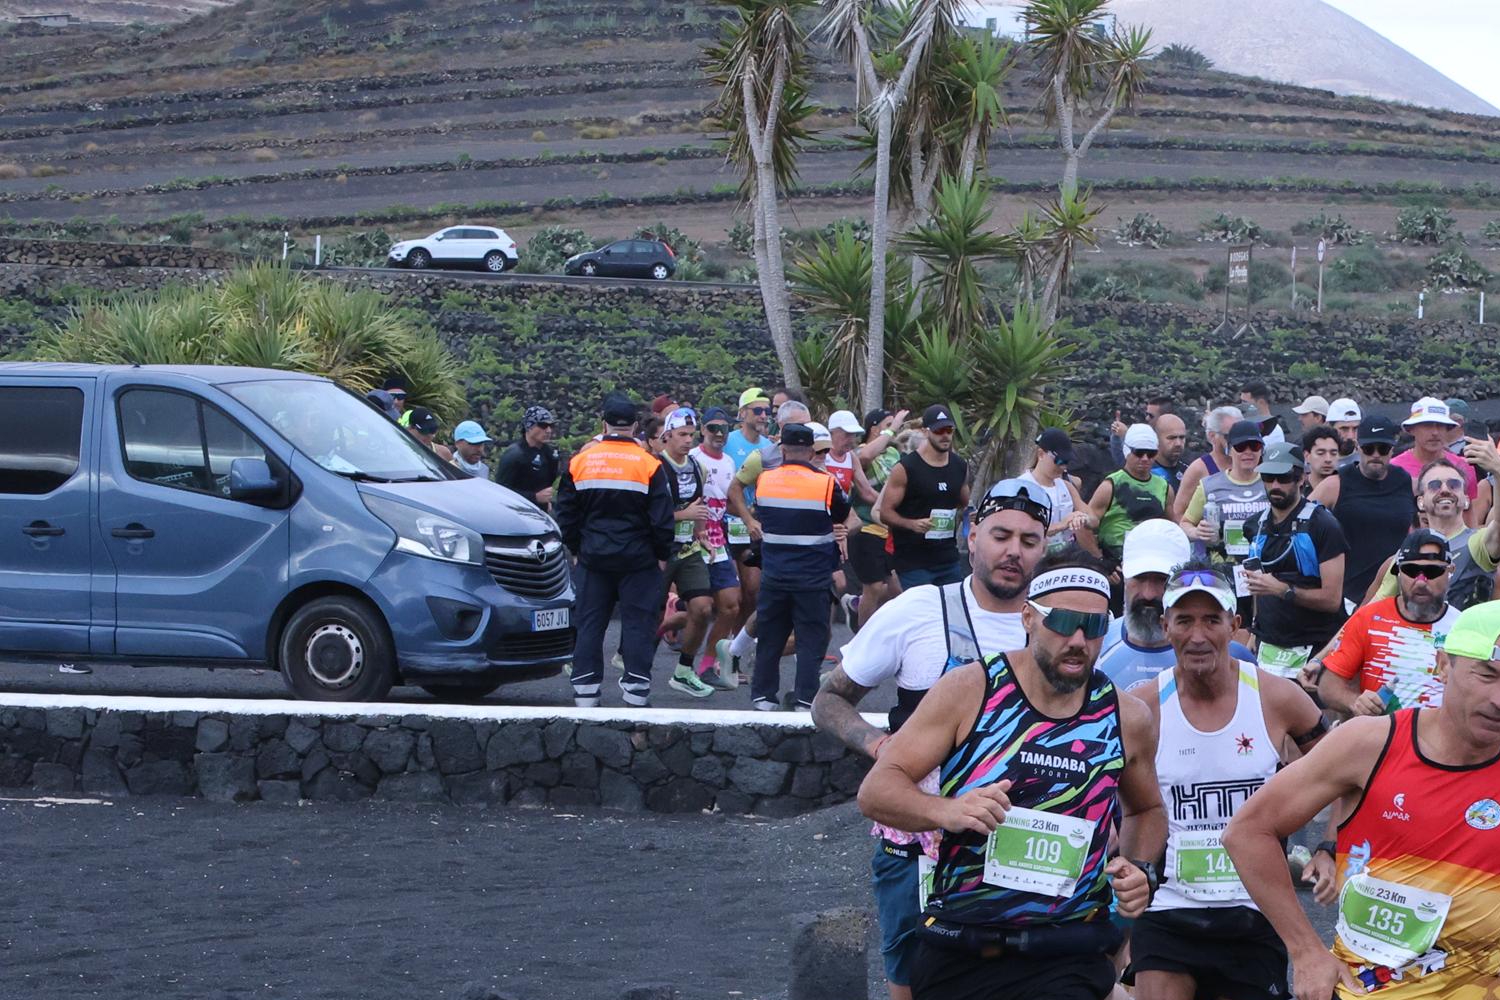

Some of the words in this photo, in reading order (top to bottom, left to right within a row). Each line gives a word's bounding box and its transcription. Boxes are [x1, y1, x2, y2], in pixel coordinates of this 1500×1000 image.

[536, 611, 555, 628] 6057
[1020, 751, 1086, 773] TAMADABA
[1033, 768, 1068, 780] SPORT
[1032, 818, 1044, 830] 23
[1045, 820, 1060, 832] Km
[1024, 836, 1062, 864] 109
[1206, 836, 1218, 847] 23
[1376, 887, 1390, 900] 23
[1391, 891, 1407, 905] Km
[1365, 905, 1407, 936] 135
